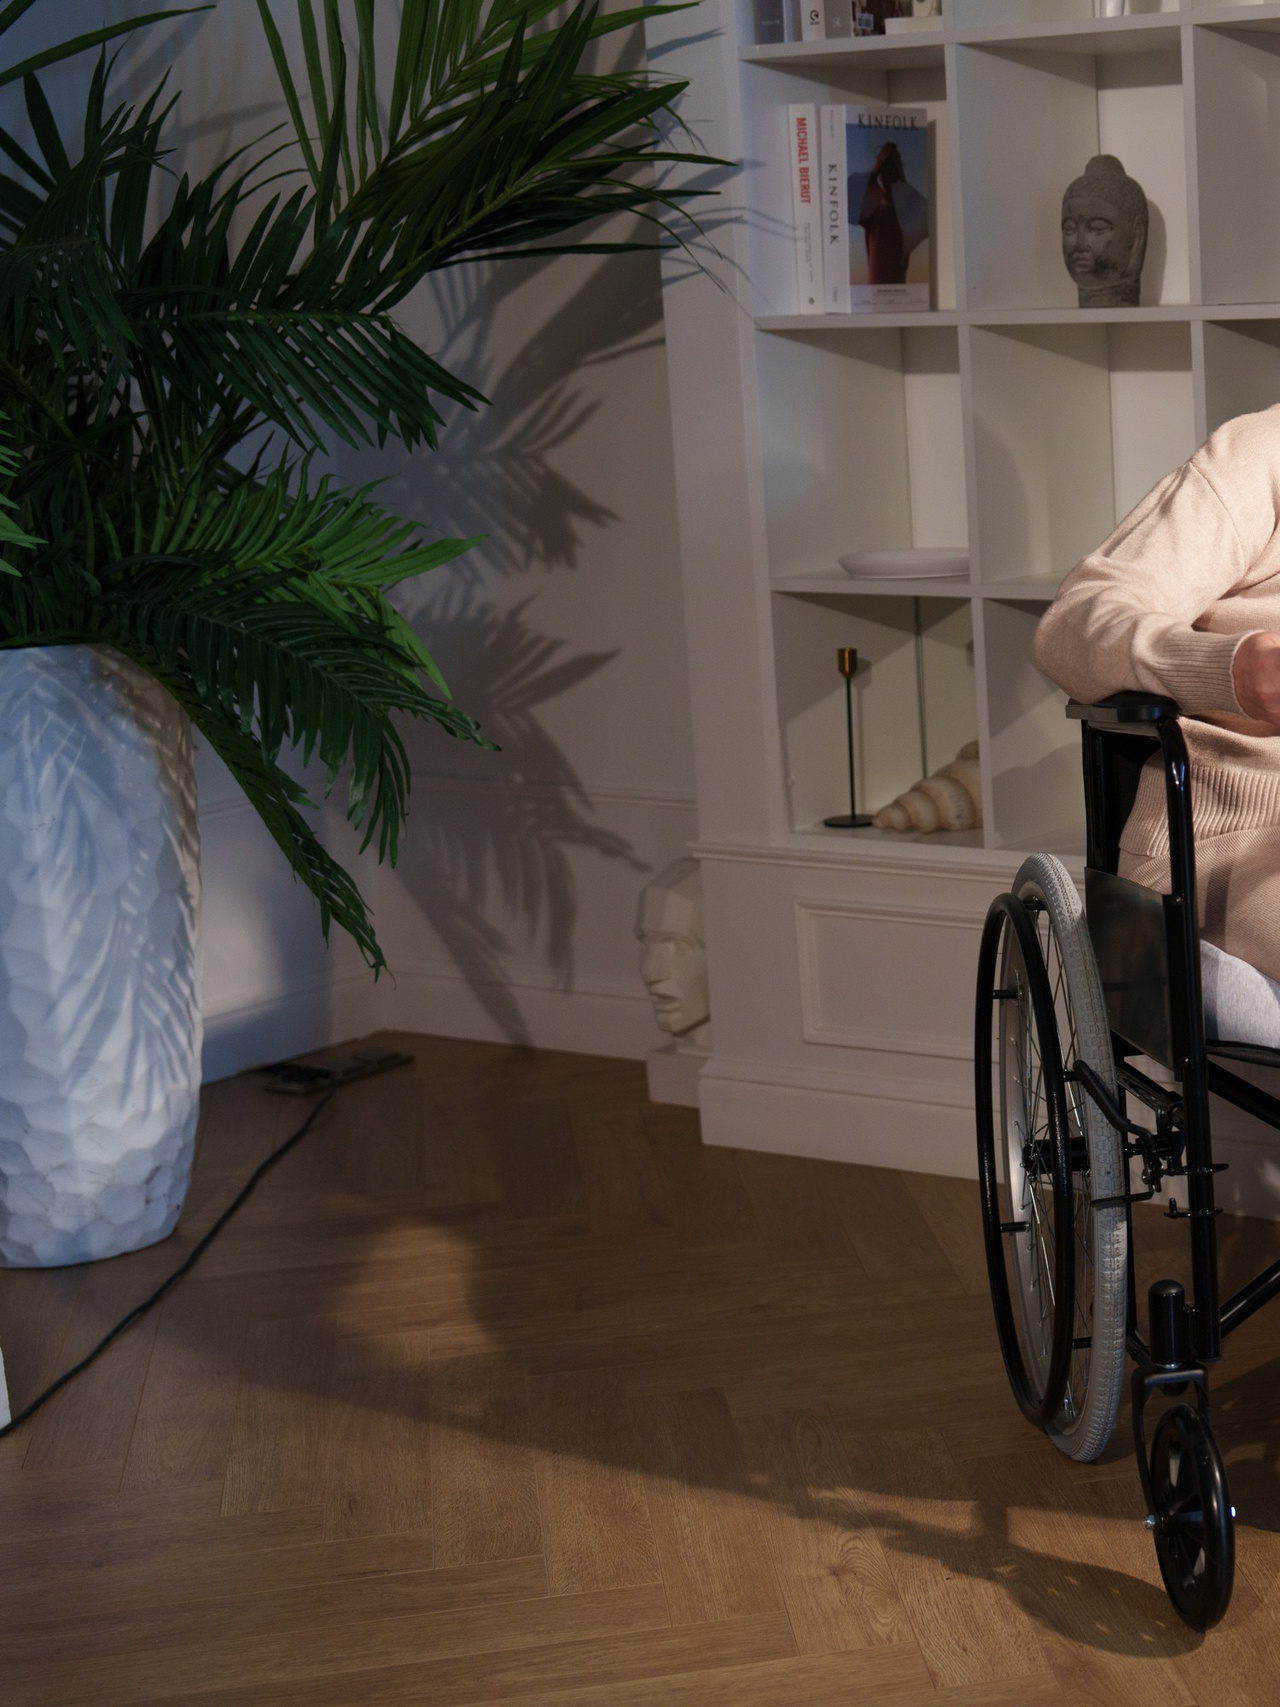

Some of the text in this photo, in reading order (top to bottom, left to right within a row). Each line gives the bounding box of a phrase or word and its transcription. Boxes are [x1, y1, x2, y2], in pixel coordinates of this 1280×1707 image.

[796, 117, 811, 204] MICHAEL BIERUT
[858, 113, 919, 130] KINFOLK
[828, 164, 840, 245] KINFOLK
